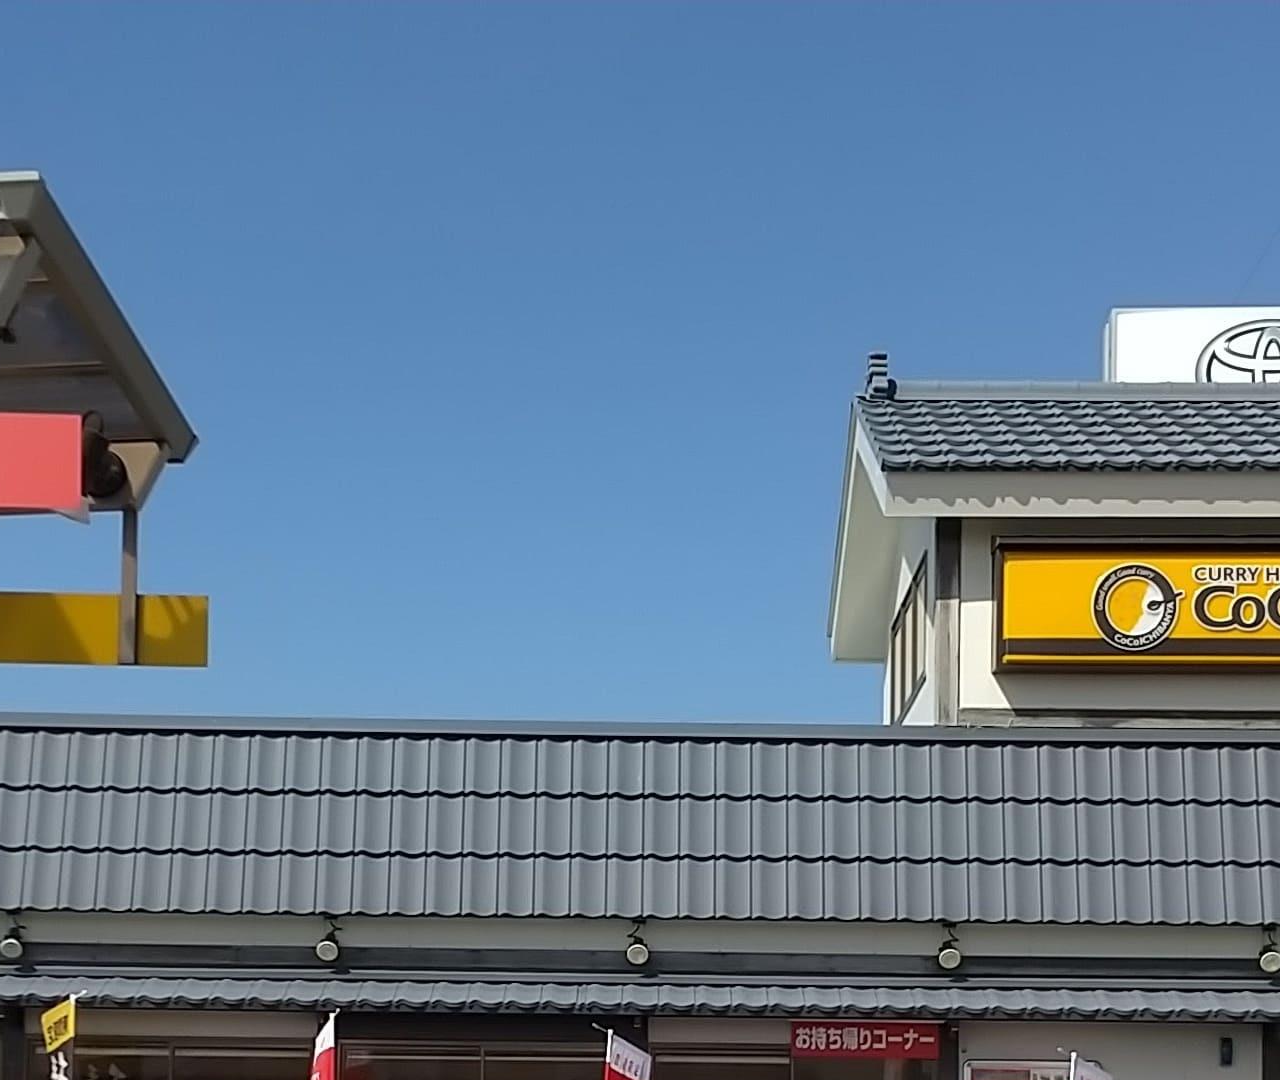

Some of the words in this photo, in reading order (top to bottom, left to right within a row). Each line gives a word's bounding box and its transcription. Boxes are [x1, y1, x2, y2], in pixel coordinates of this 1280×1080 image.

[1194, 567, 1259, 582] CURRY
[795, 1026, 935, 1050] お持ち帰りコーナー
